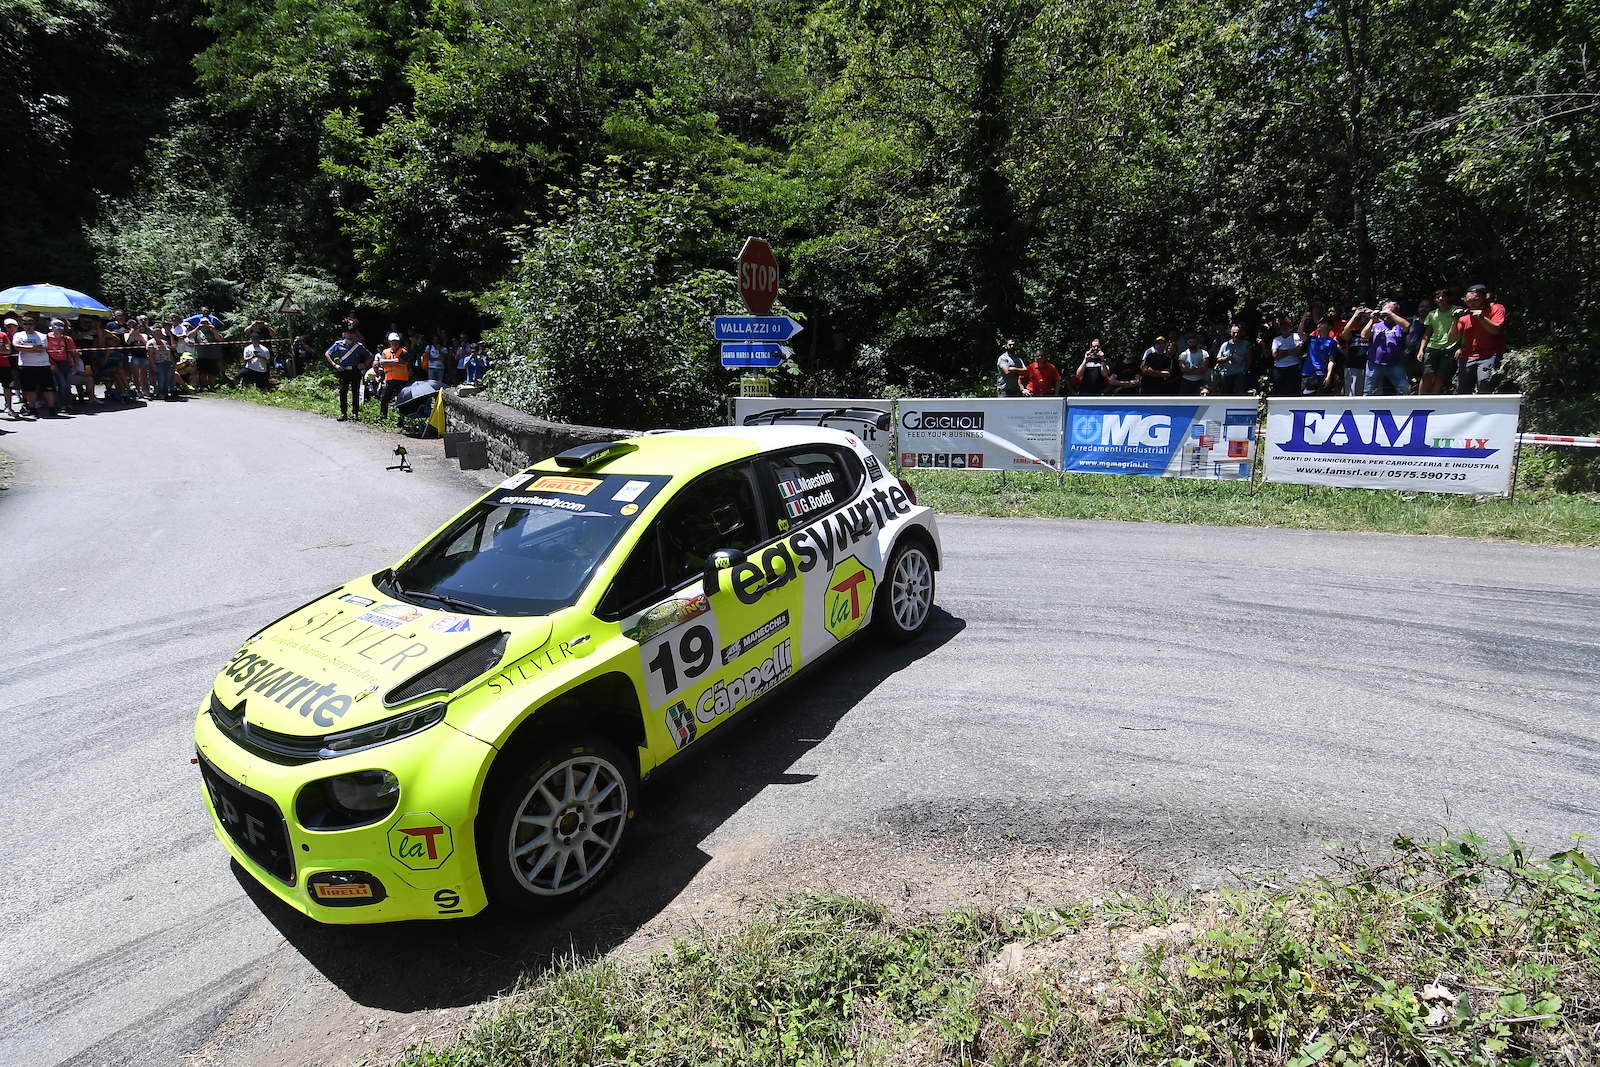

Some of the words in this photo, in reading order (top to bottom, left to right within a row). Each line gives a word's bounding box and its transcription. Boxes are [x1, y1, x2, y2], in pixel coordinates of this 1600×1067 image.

[742, 262, 777, 293] STOP
[721, 323, 769, 333] VALLAZZI
[722, 351, 735, 359] SANTA
[736, 351, 750, 359] MARIA
[751, 351, 755, 359] A
[743, 385, 768, 393] STRADA
[924, 416, 982, 429] GIGLIOLI
[1101, 414, 1171, 446] MG
[949, 431, 984, 439] BUSINESS
[1283, 409, 1436, 452] FAM
[1070, 444, 1122, 453] Arredamenti
[1124, 446, 1169, 454] Industriali
[1432, 437, 1490, 450] ITALY
[1079, 459, 1149, 469] www.mgmagrini.it
[1313, 457, 1366, 465] VERNICIATURA
[1385, 460, 1442, 468] CARROZZERIA
[1452, 462, 1500, 470] INDUSTRIA
[792, 469, 835, 494] L.Maestrini
[1296, 467, 1377, 477] www.famsrl.eu
[1387, 470, 1467, 481] 0575.590733
[534, 478, 594, 492] PIRELLI
[500, 496, 586, 512] easywriterally.com
[799, 489, 835, 513] G.Boddi
[731, 485, 911, 605] easywrite
[289, 610, 429, 672] SYLVER
[649, 624, 714, 696] 19
[487, 641, 574, 695] SYLVER
[695, 637, 793, 723] Cappelli
[221, 648, 352, 728] easywrite
[318, 883, 368, 897] PIRELLI
